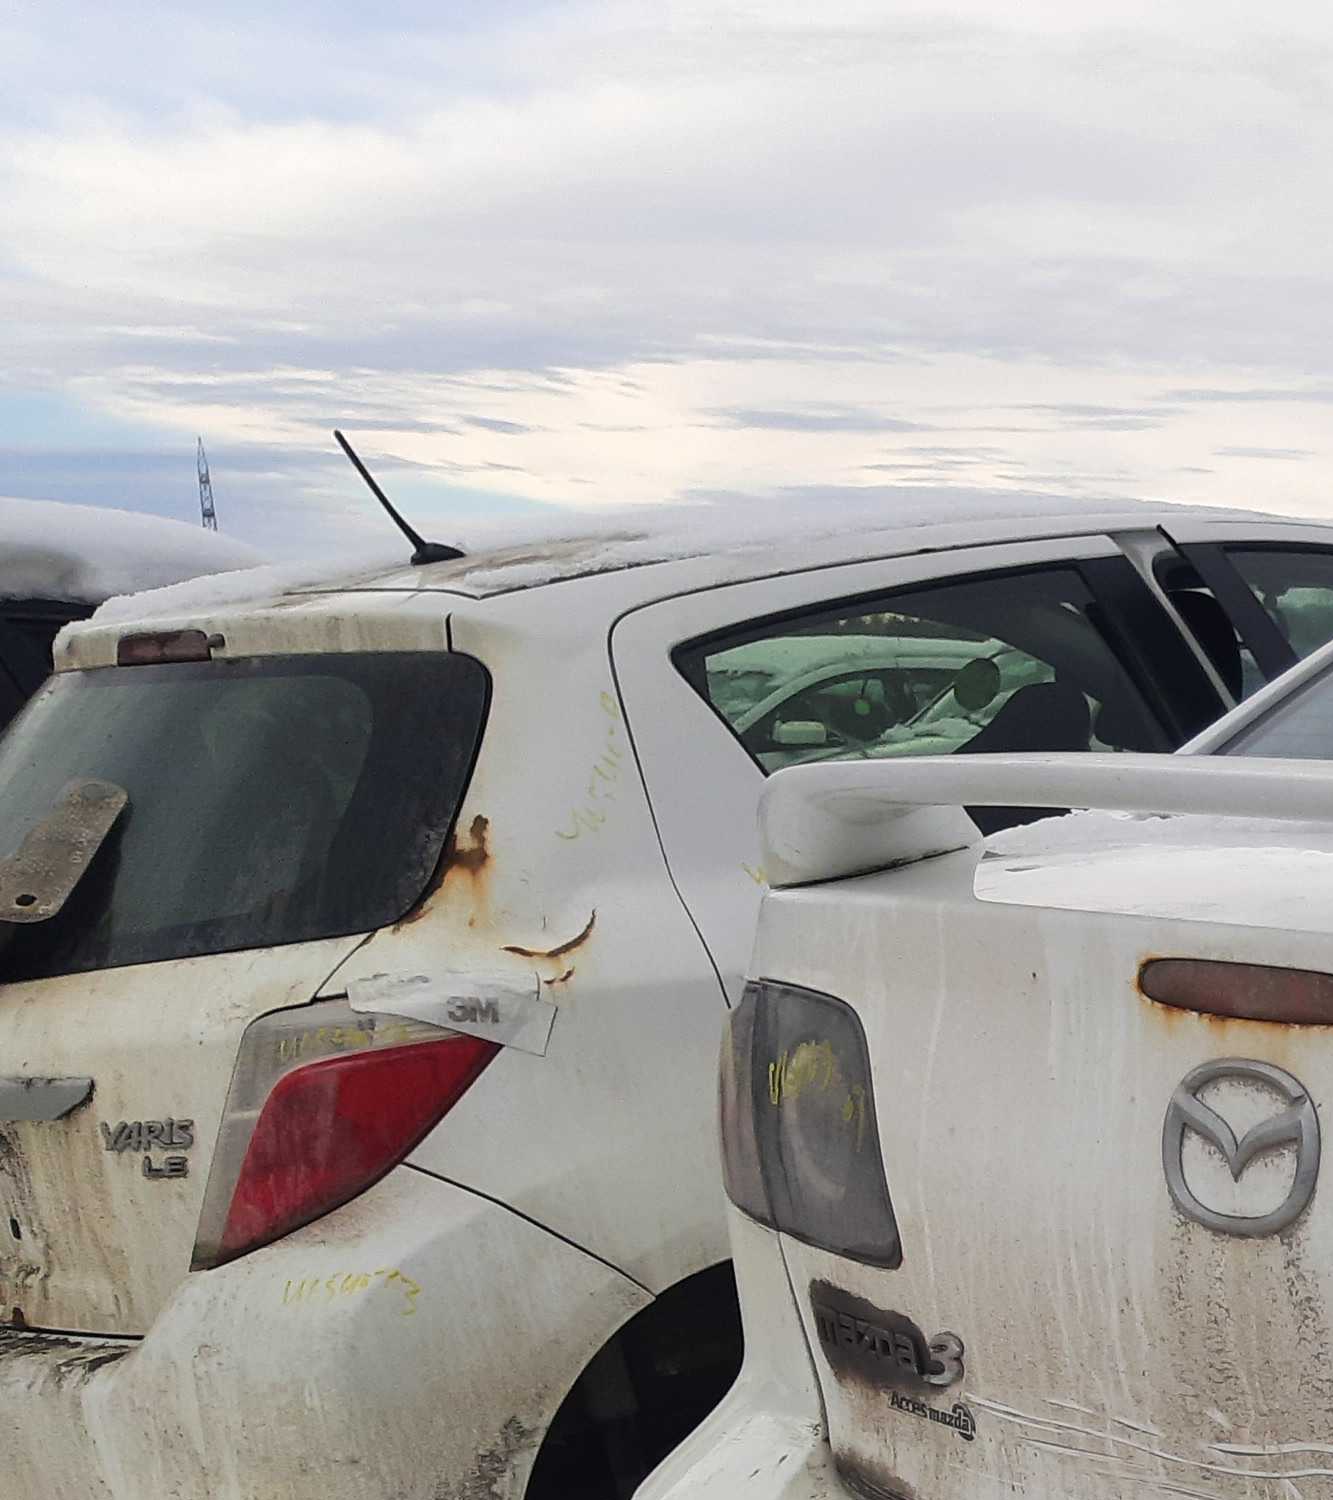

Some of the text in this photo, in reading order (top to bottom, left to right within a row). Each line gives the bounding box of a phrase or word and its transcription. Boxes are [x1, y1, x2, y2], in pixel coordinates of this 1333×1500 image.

[448, 996, 500, 1024] 3M
[100, 1117, 194, 1152] YARIS
[143, 1155, 189, 1180] LE
